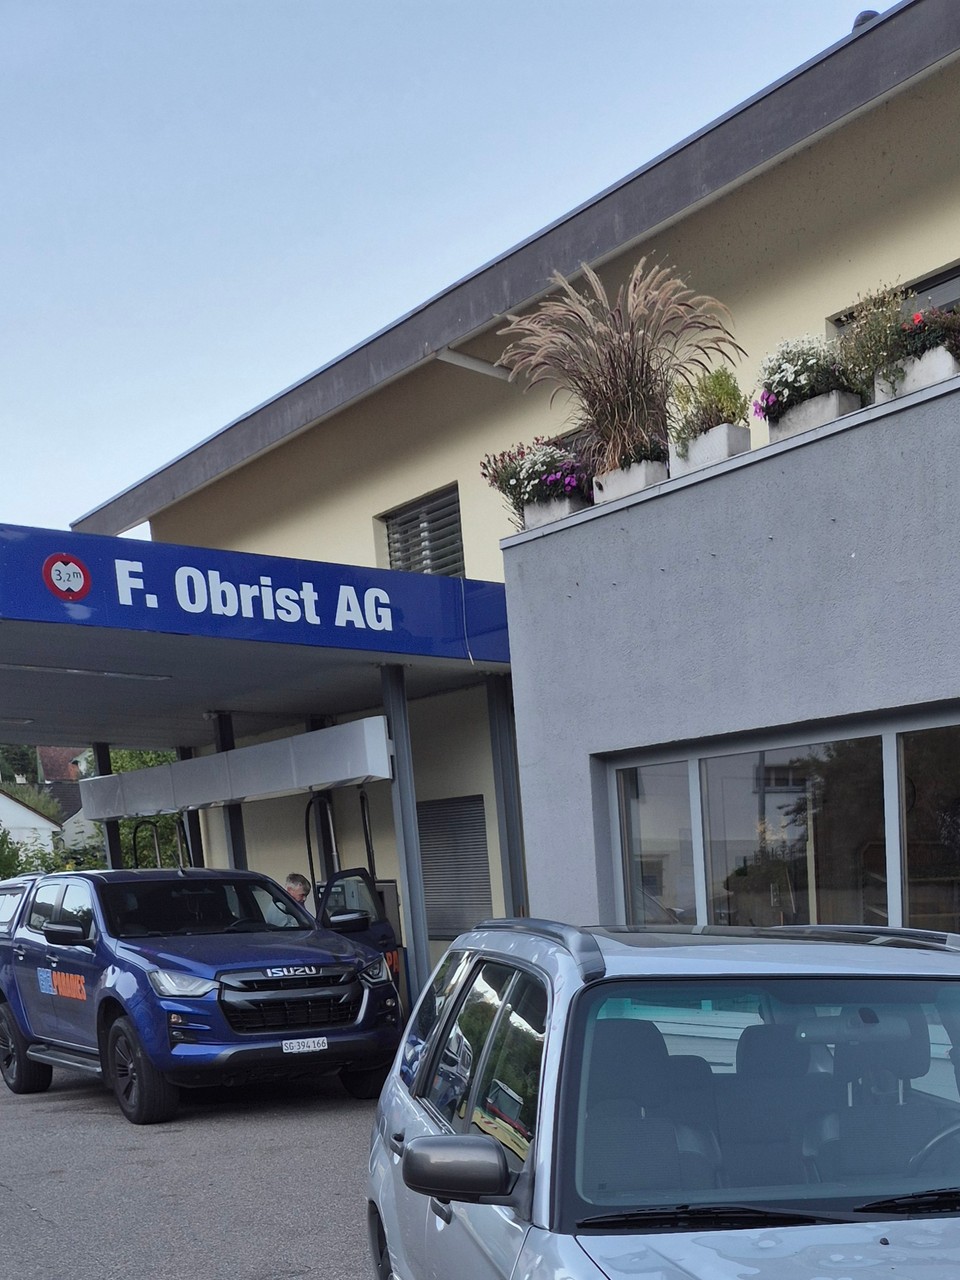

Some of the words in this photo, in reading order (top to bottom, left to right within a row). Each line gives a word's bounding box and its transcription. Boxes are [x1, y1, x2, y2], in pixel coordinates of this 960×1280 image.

[114, 559, 159, 609] F.
[174, 566, 321, 625] Obrist
[334, 585, 394, 632] AG
[266, 966, 317, 977] ISUZU
[284, 1042, 295, 1052] SG
[297, 1041, 311, 1051] 394
[312, 1038, 327, 1049] 166
